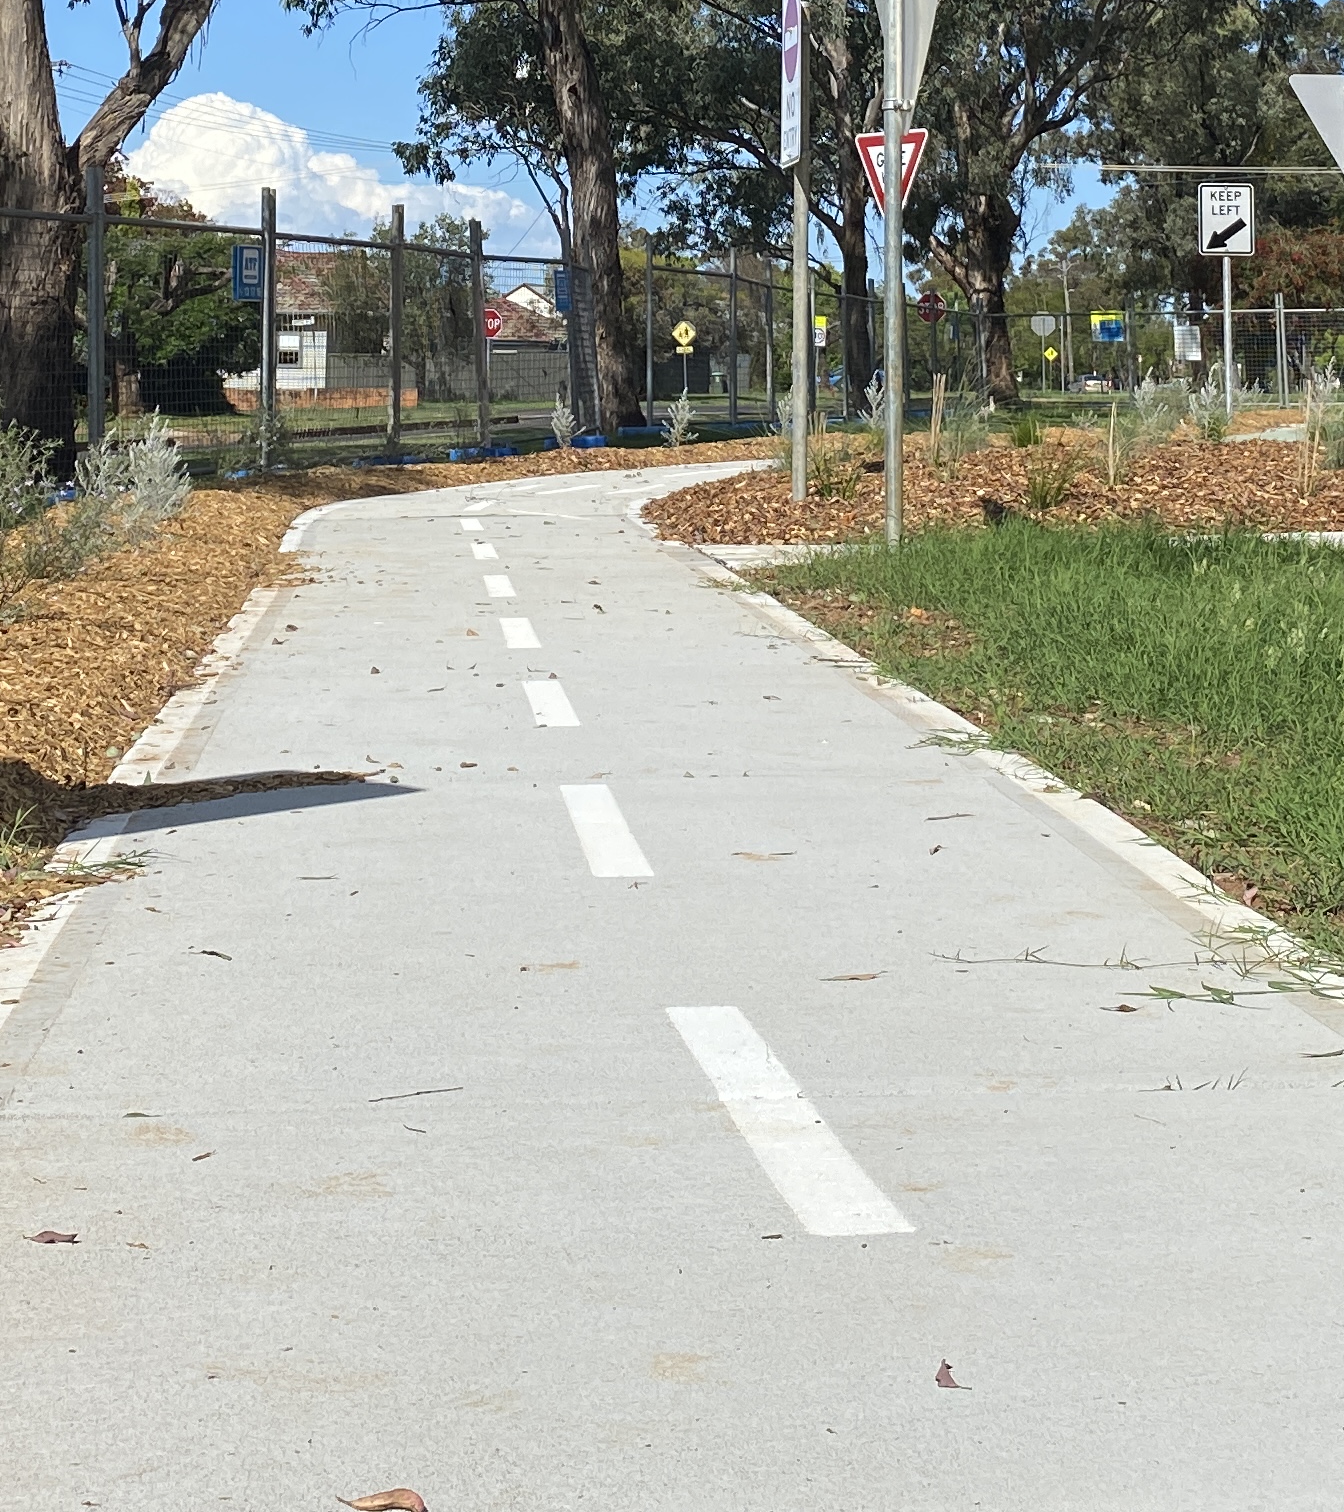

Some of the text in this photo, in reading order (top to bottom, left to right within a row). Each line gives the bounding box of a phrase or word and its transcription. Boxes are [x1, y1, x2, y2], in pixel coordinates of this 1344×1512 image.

[786, 91, 796, 120] NO
[876, 151, 906, 168] GE
[1210, 190, 1242, 201] KEEP
[1211, 205, 1241, 216] LEFT
[918, 302, 944, 315] STP
[485, 318, 501, 330] OP
